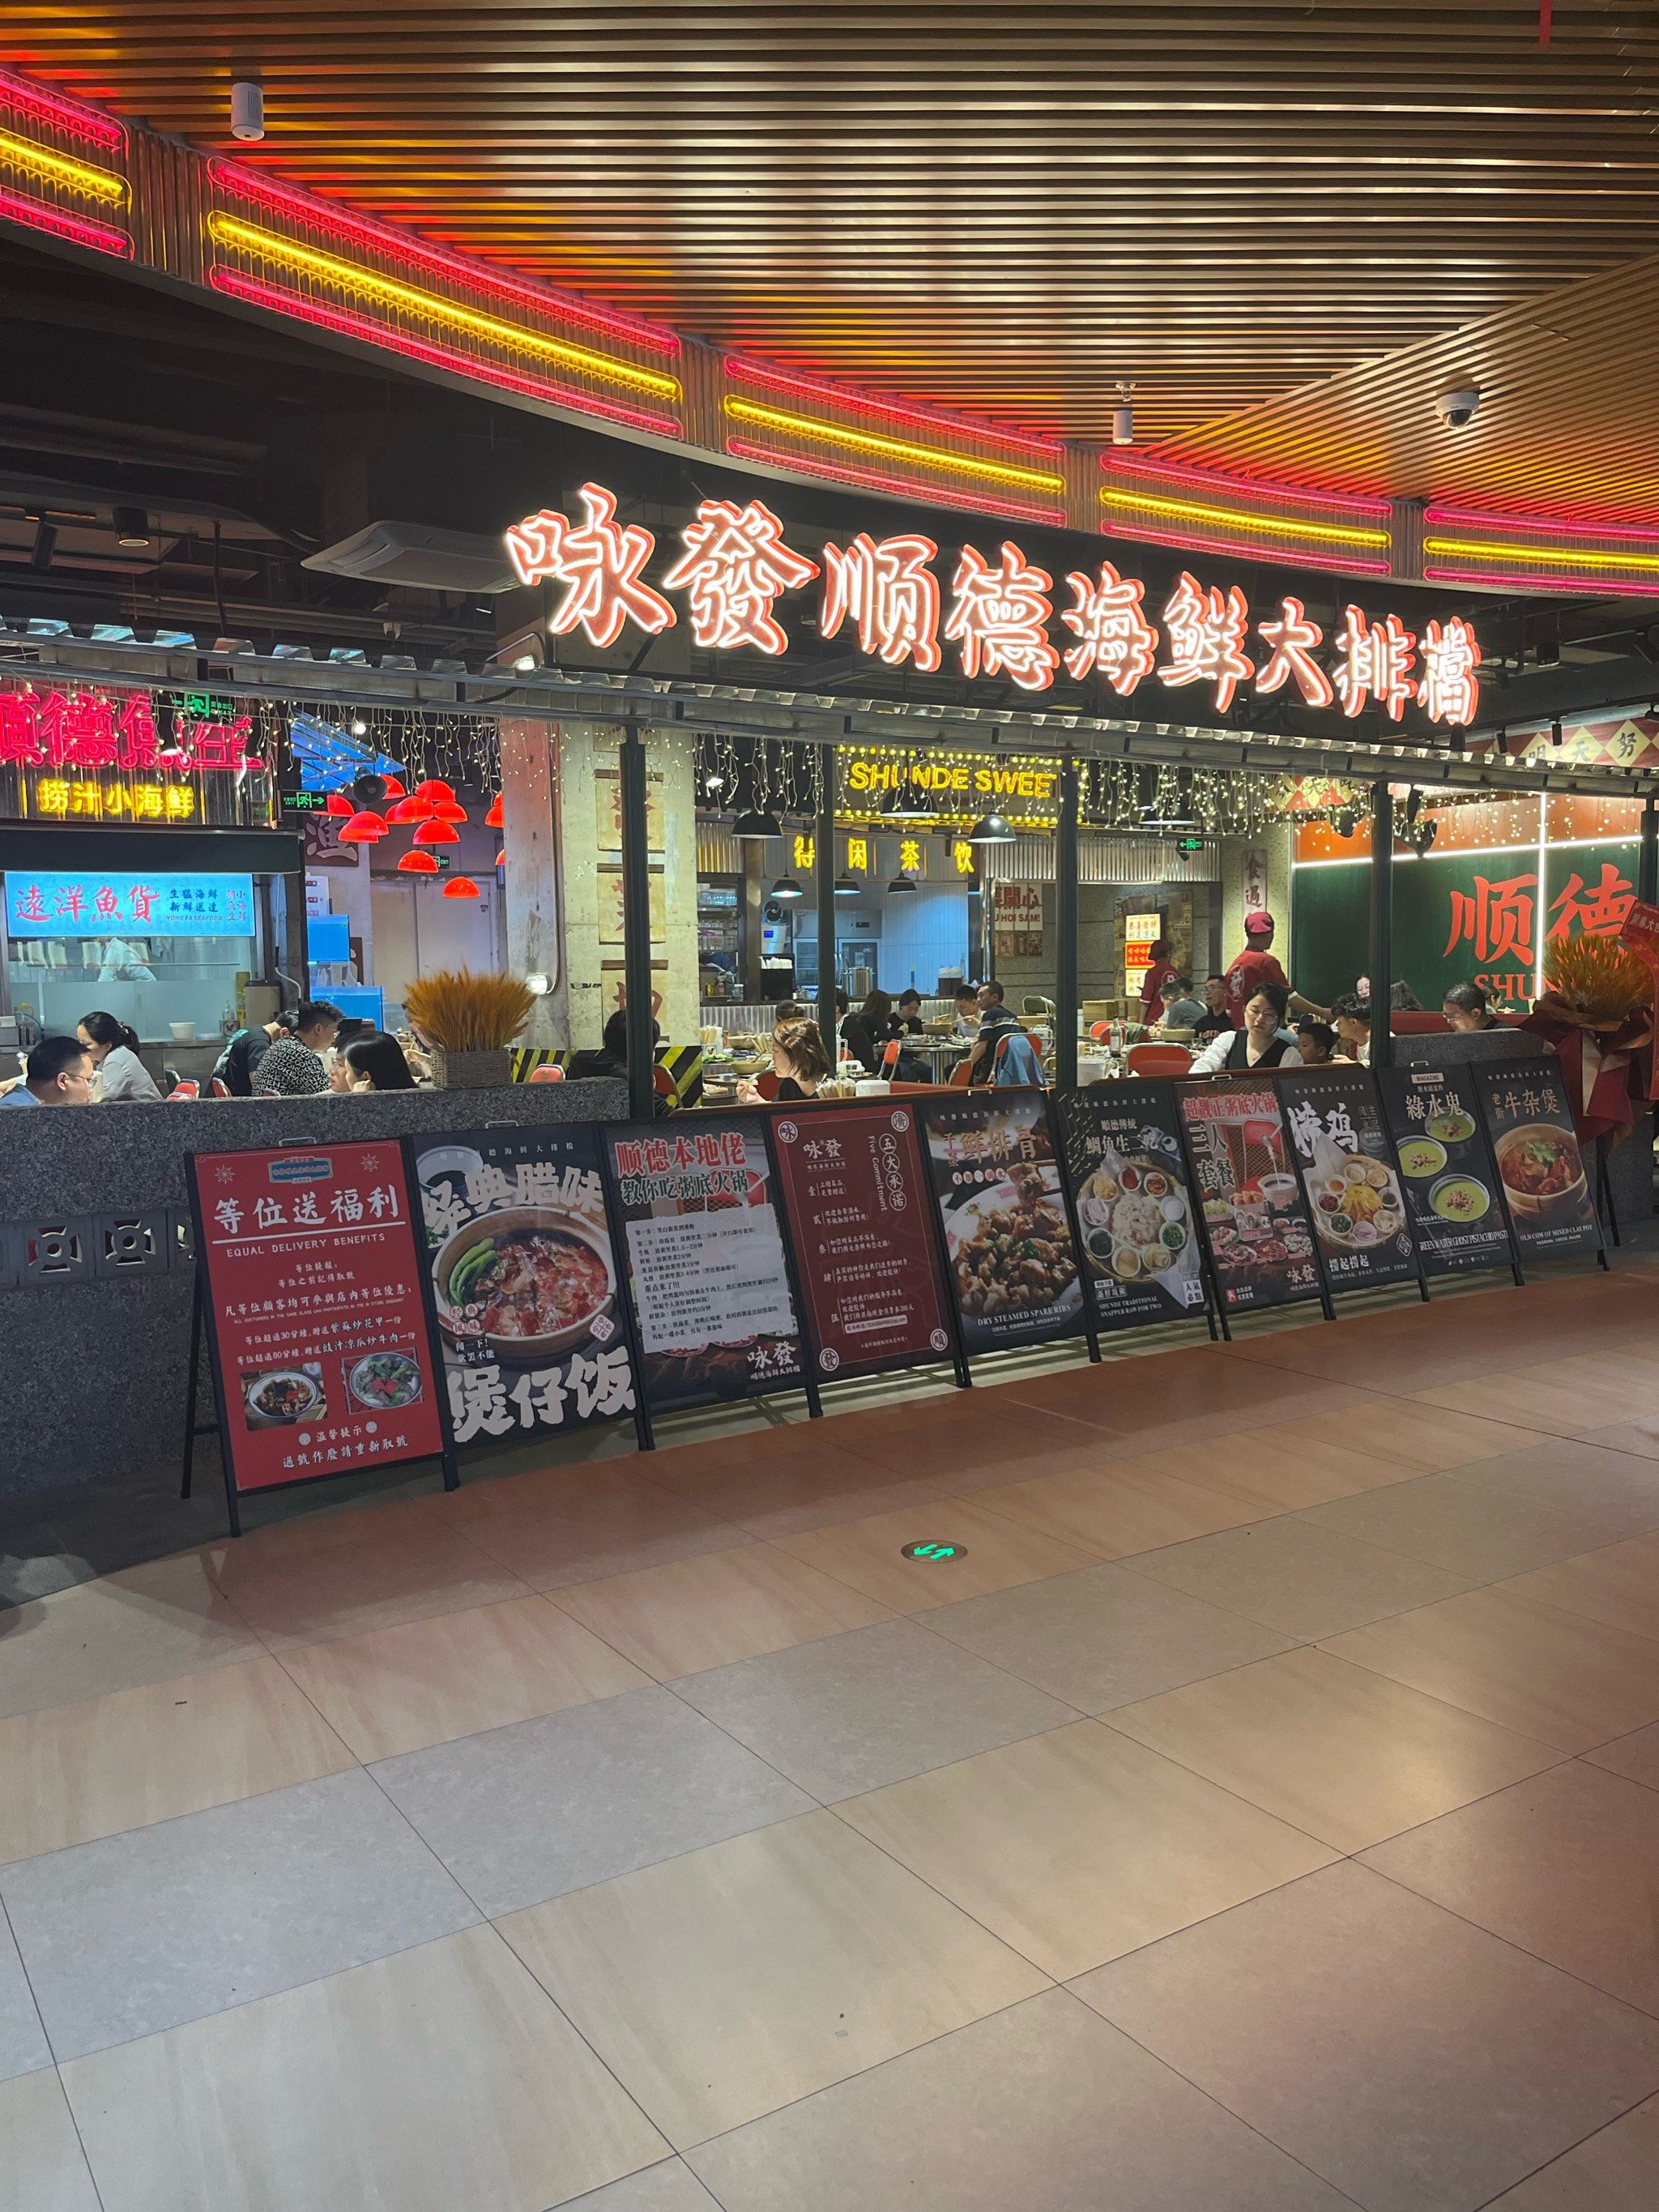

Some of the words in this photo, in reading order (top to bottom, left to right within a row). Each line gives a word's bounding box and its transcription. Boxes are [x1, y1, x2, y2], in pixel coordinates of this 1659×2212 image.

[39, 779, 195, 818] 捞汁小海鲜
[15, 885, 160, 924] 遠洋魚貨
[1405, 1091, 1465, 1121] 綠水鬼
[1504, 1087, 1560, 1119] 牛杂煲
[615, 1132, 746, 1179] 顺德本地佬
[803, 1138, 842, 1159] 咏發
[621, 1169, 749, 1206] 教你吃粥底火锅
[868, 1136, 876, 1154] Five
[872, 1157, 889, 1212] Commitment
[882, 1137, 904, 1207] 五大承诺
[1196, 1159, 1235, 1192] 套餐
[213, 1184, 399, 1235] 等位送福利
[227, 1247, 265, 1258] EQUAL
[272, 1239, 327, 1253] DELIVERY
[334, 1232, 386, 1246] BENEFITS
[1520, 1233, 1532, 1241] OLD
[1532, 1231, 1544, 1240] COW
[1552, 1227, 1570, 1236] MIXED
[1569, 1225, 1582, 1234] CLAY
[1582, 1223, 1593, 1232] POT
[977, 1317, 993, 1326] DRY
[994, 1311, 1030, 1324] STEAMED
[1030, 1306, 1053, 1317] SPARE
[1054, 1305, 1071, 1313] RIBS
[746, 1341, 797, 1369] 咏發
[446, 1346, 637, 1442] 煲仔饭
